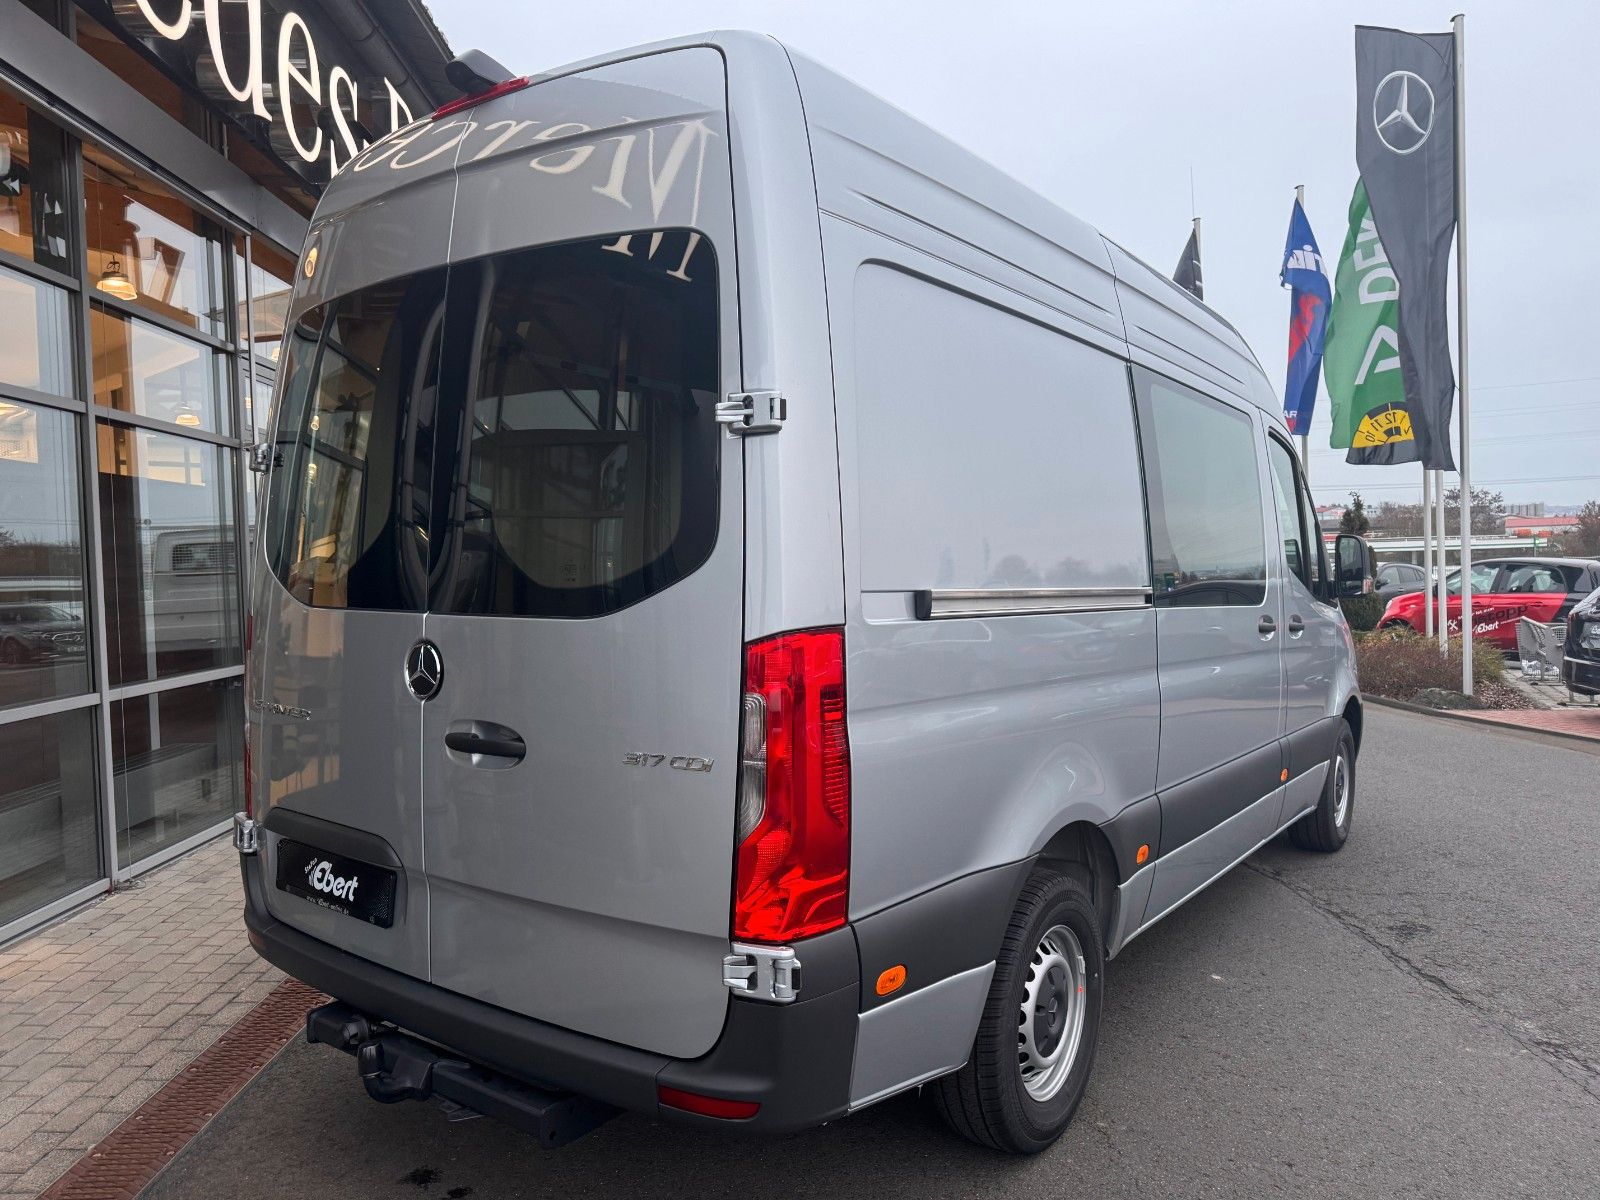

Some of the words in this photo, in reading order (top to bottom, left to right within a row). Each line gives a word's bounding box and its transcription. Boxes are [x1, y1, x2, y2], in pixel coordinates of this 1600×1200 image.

[622, 752, 667, 768] 317
[670, 755, 715, 773] CDI
[313, 860, 359, 902] Ebert
